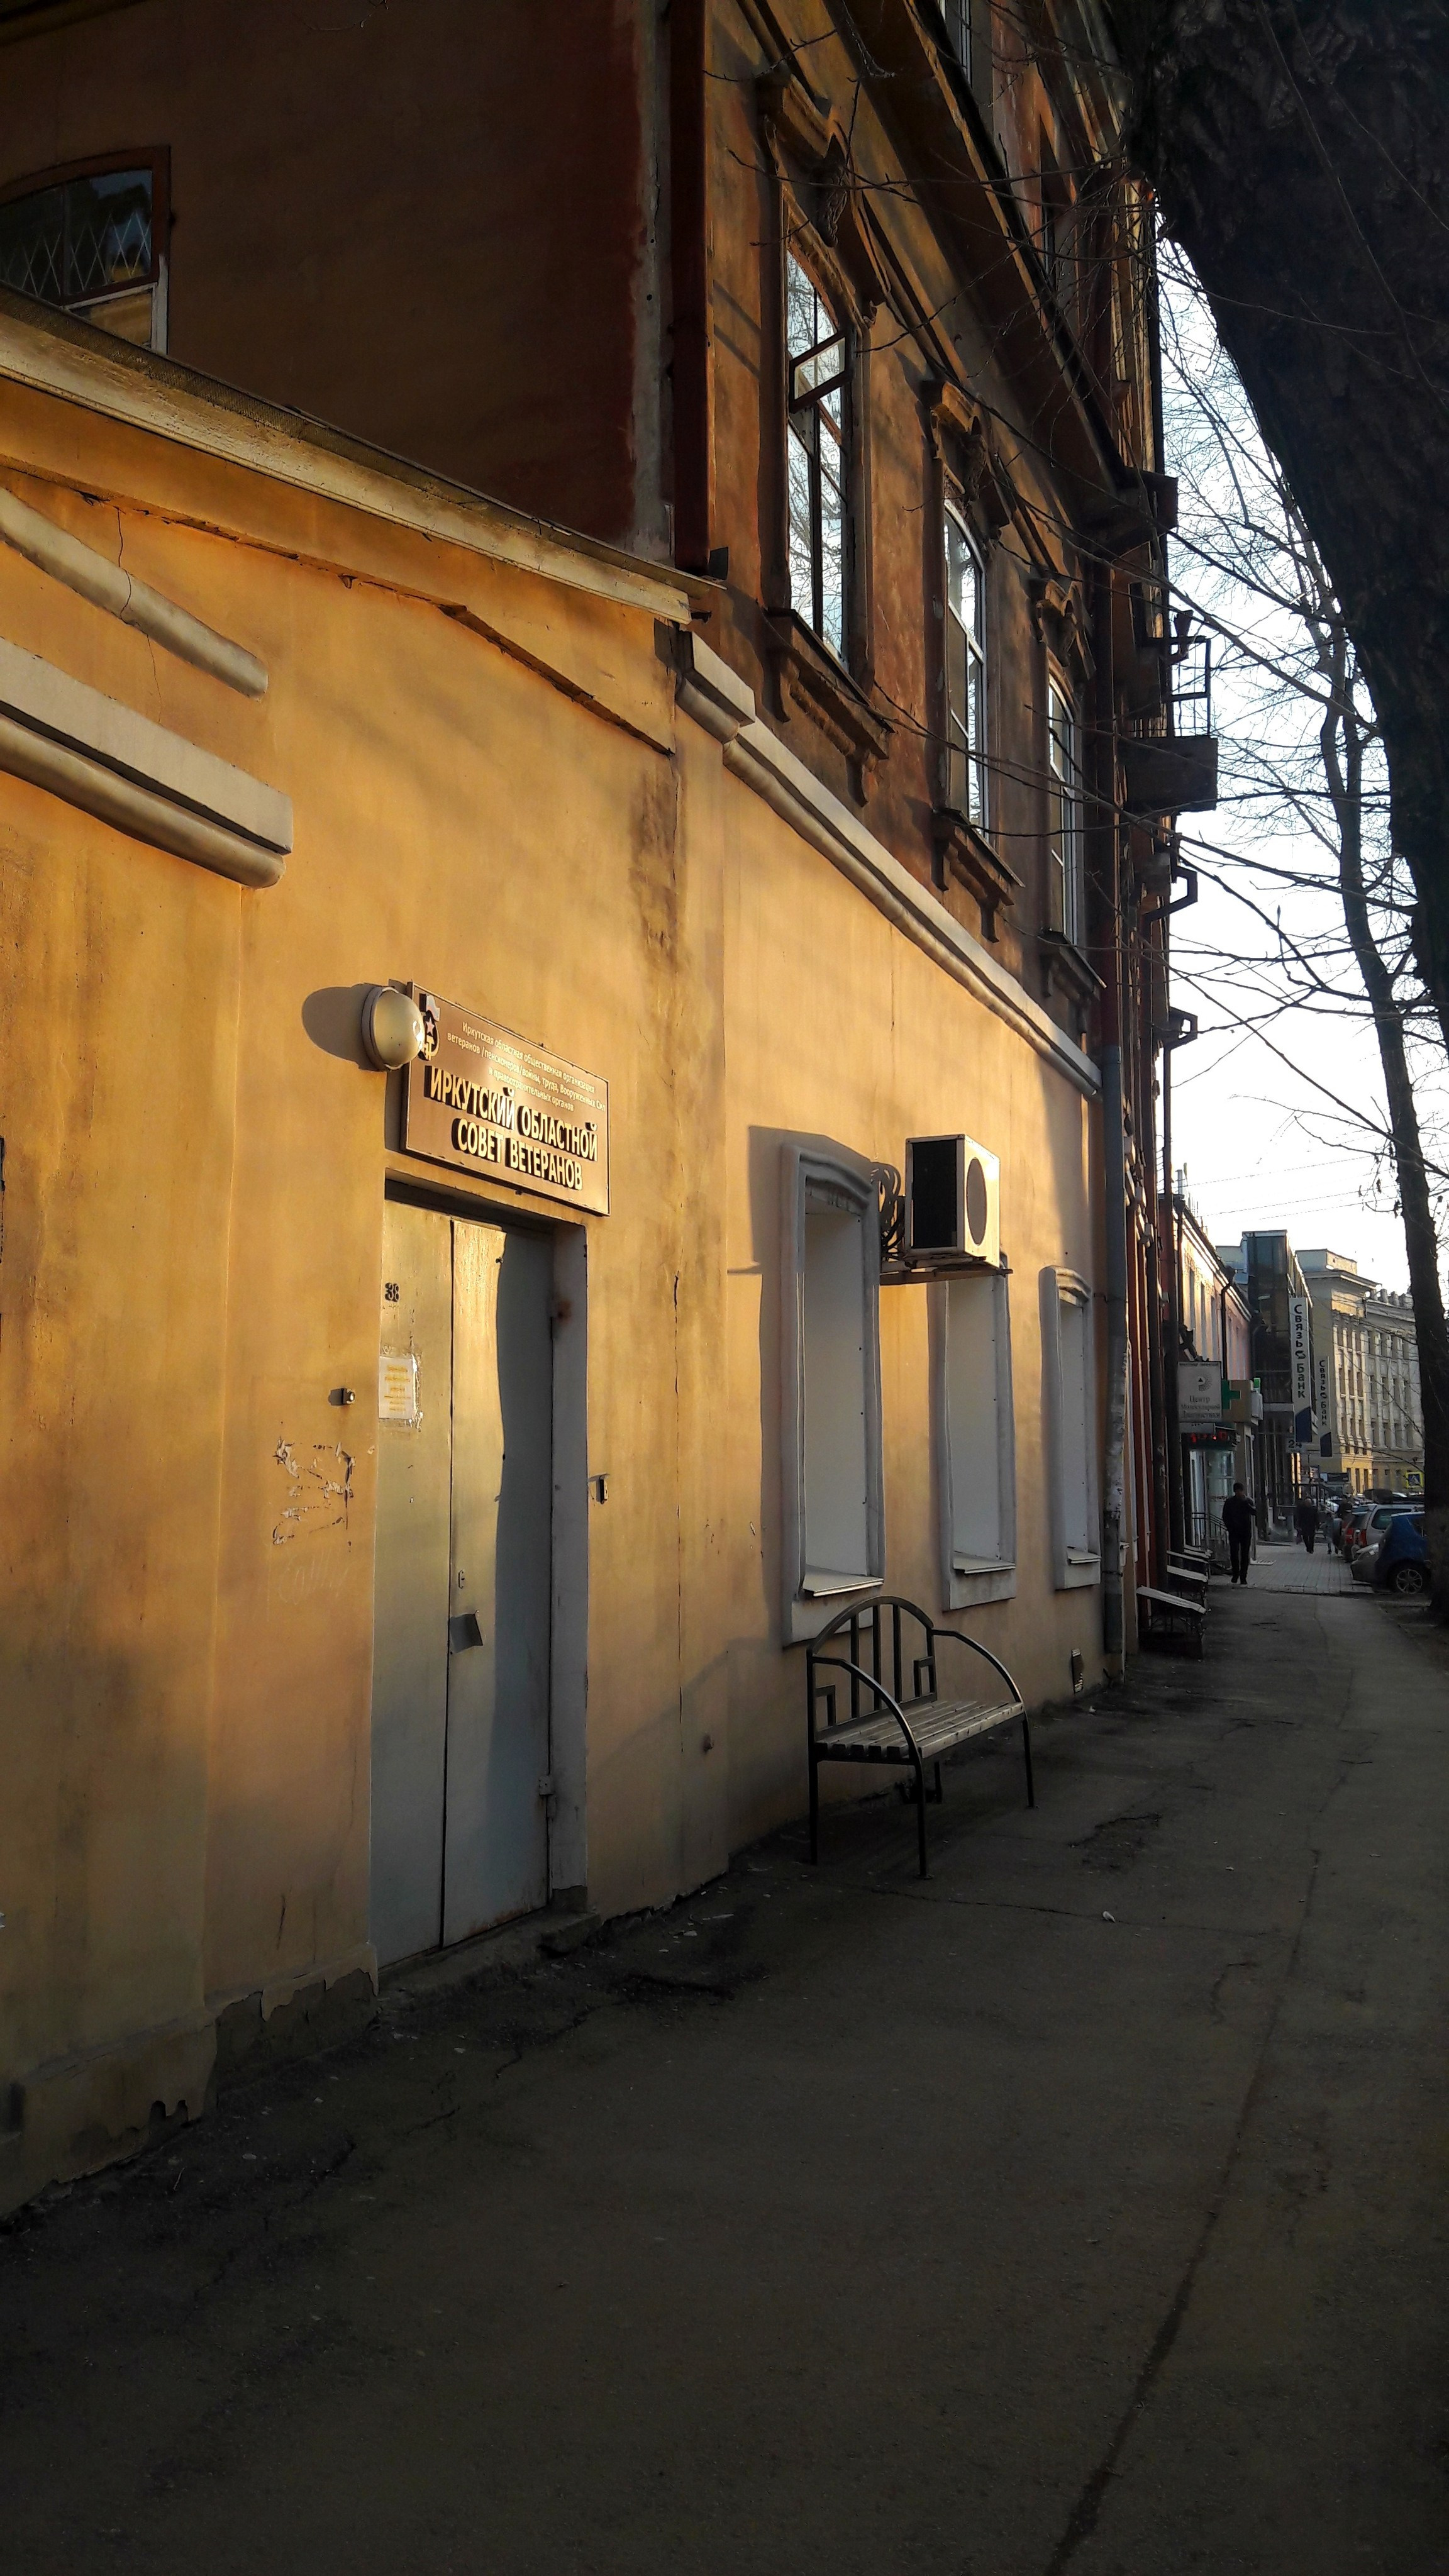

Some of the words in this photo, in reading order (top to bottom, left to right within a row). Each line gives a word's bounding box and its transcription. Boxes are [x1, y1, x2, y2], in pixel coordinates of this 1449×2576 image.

[447, 1032, 480, 1054] ветеранов
[541, 1077, 559, 1093] труда,
[560, 1084, 596, 1108] Вооруженных
[462, 1021, 494, 1045] Иркутская
[494, 1039, 523, 1060] областная
[524, 1054, 562, 1078] общественная
[563, 1075, 595, 1094] организация
[429, 1066, 515, 1130] ИРКУТСКИЙ
[521, 1105, 597, 1162] ОБЛАСТНОЙ
[494, 1070, 551, 1102] правоохранительных
[552, 1097, 574, 1111] органов
[457, 1118, 503, 1163] СОВЕТ
[510, 1137, 582, 1190] ВЕТЕРАНОВ
[385, 1282, 400, 1302] 38
[1294, 1304, 1304, 1348] Связь
[1296, 1363, 1306, 1399] Банк
